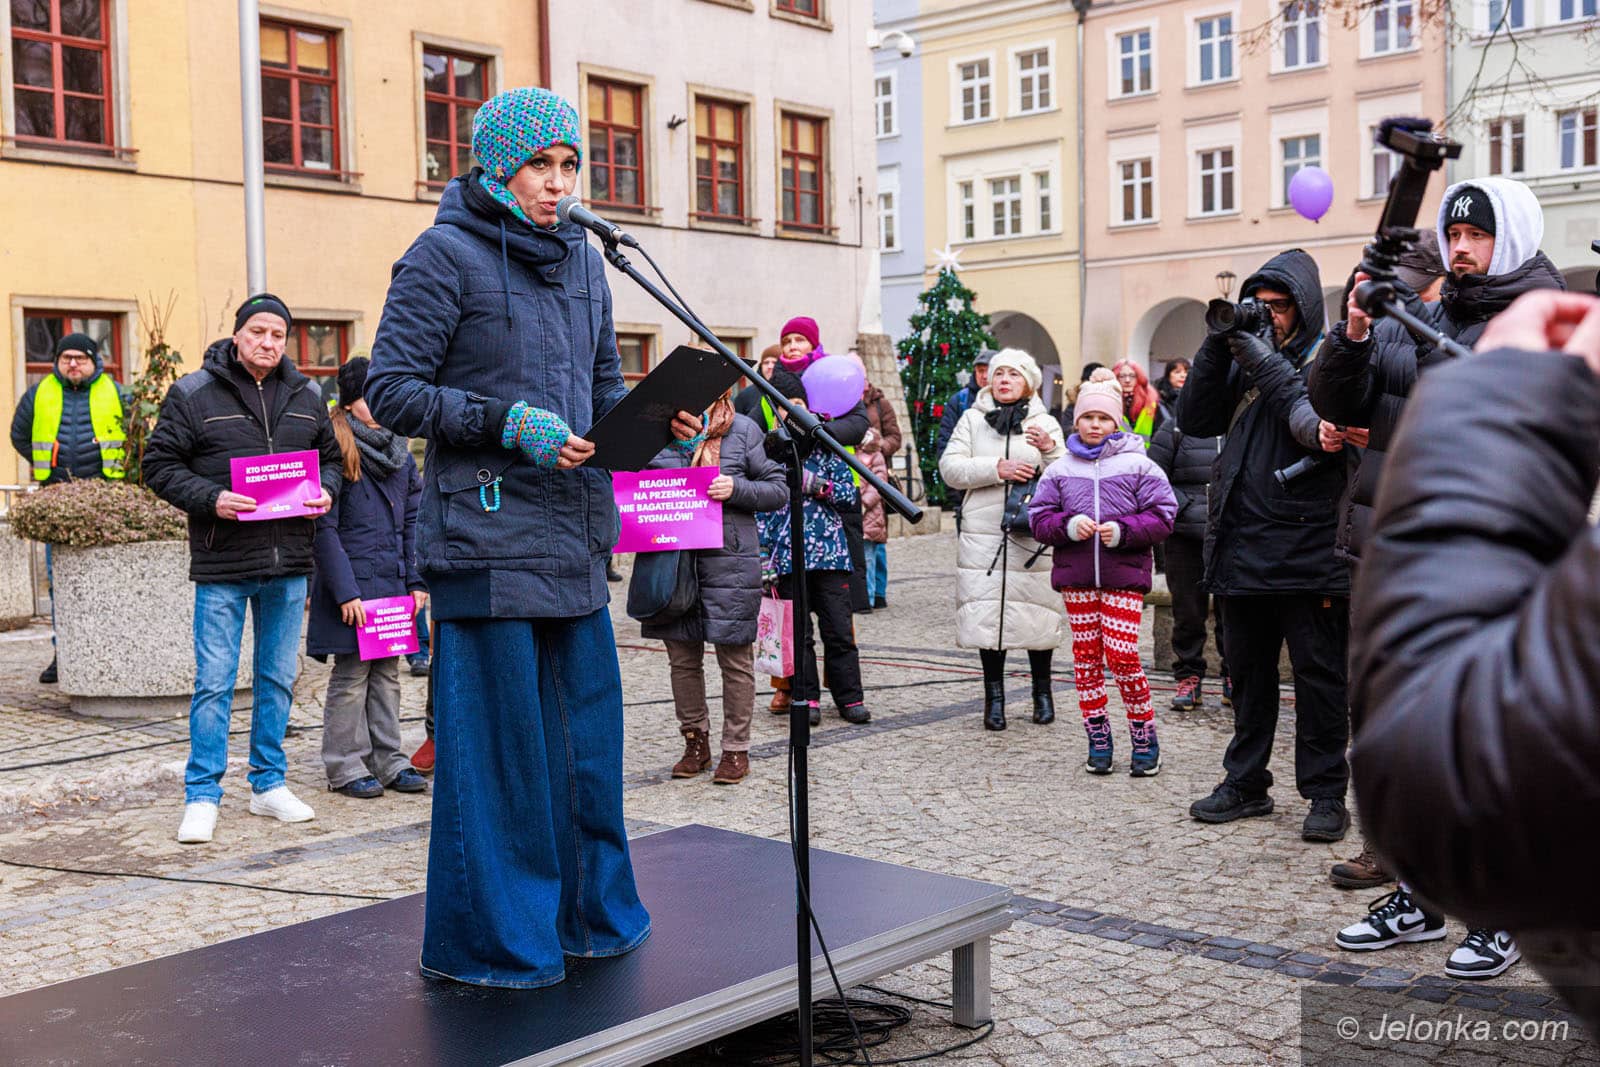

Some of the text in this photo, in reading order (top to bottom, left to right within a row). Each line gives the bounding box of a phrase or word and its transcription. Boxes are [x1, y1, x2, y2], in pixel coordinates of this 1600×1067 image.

[245, 461, 304, 474] KTO UCZY NASZE
[245, 475, 268, 483] DZIECI
[638, 477, 687, 489] REAGUJMY
[633, 492, 648, 501] NA
[620, 500, 709, 513] NIE BAGATELIZUJMY
[638, 511, 693, 523] SYGNAŁÓW!
